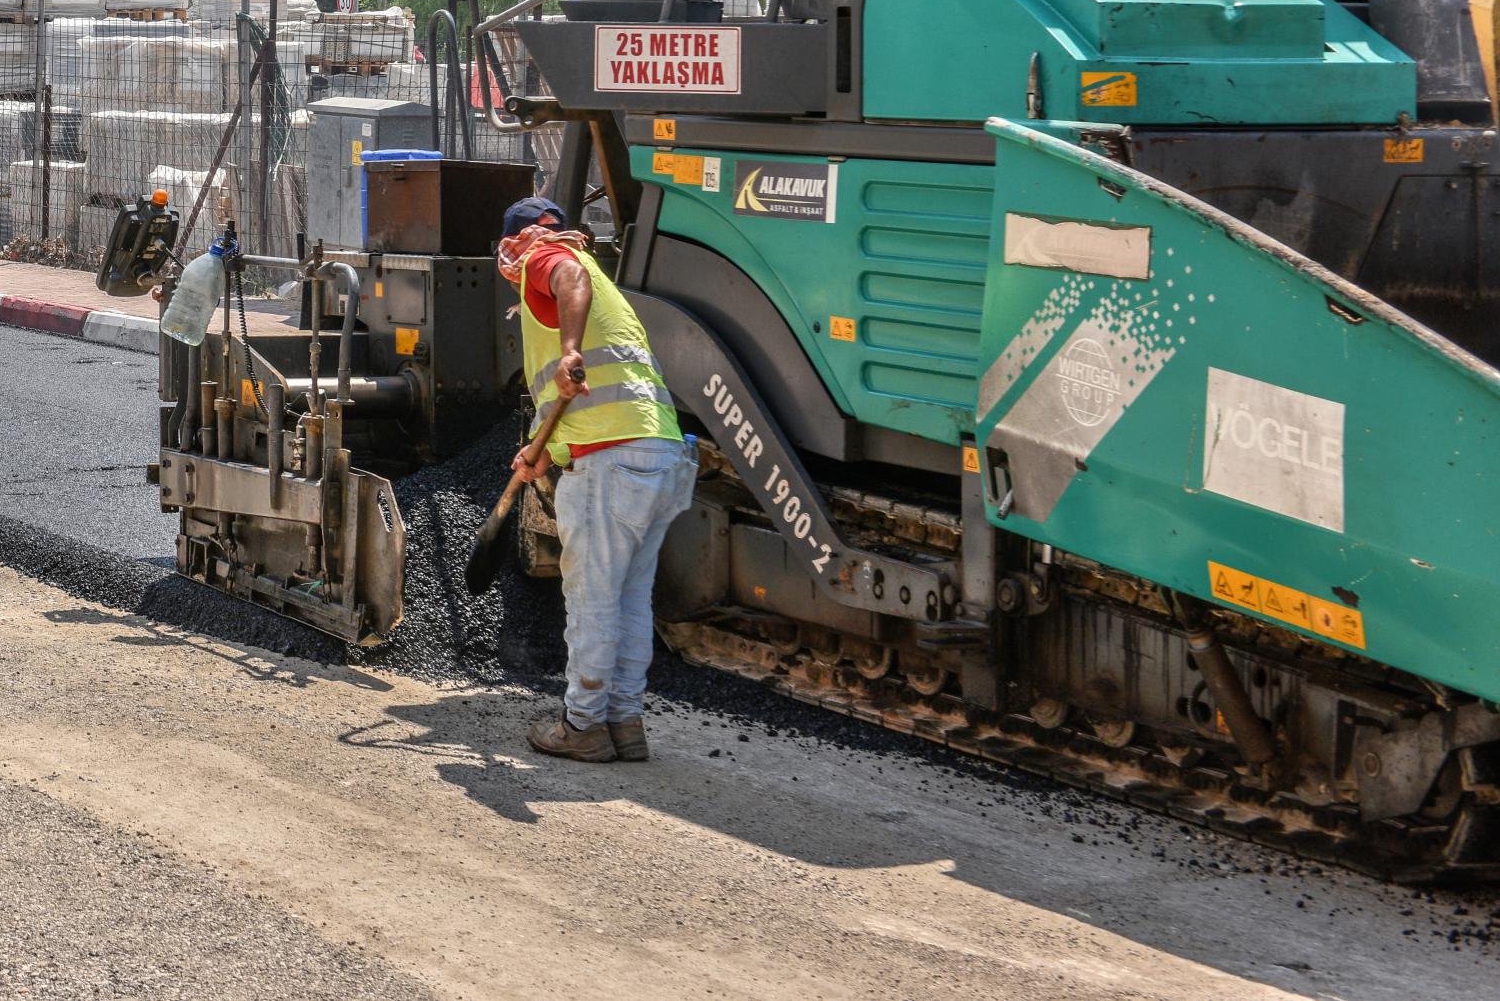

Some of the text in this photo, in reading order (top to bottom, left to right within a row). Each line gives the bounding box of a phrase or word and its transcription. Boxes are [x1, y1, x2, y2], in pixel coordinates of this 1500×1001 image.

[616, 33, 719, 57] 25 METRE
[610, 60, 725, 88] YAKLAŞMA
[759, 175, 827, 198] ALAKAVUK
[769, 204, 793, 213] ASFALT
[794, 206, 799, 214] &
[1058, 356, 1121, 390] WIRTGEN
[1060, 379, 1115, 406] GROUP
[1209, 400, 1342, 477] VÖGELE
[702, 373, 833, 574] SUPER 1900-2
